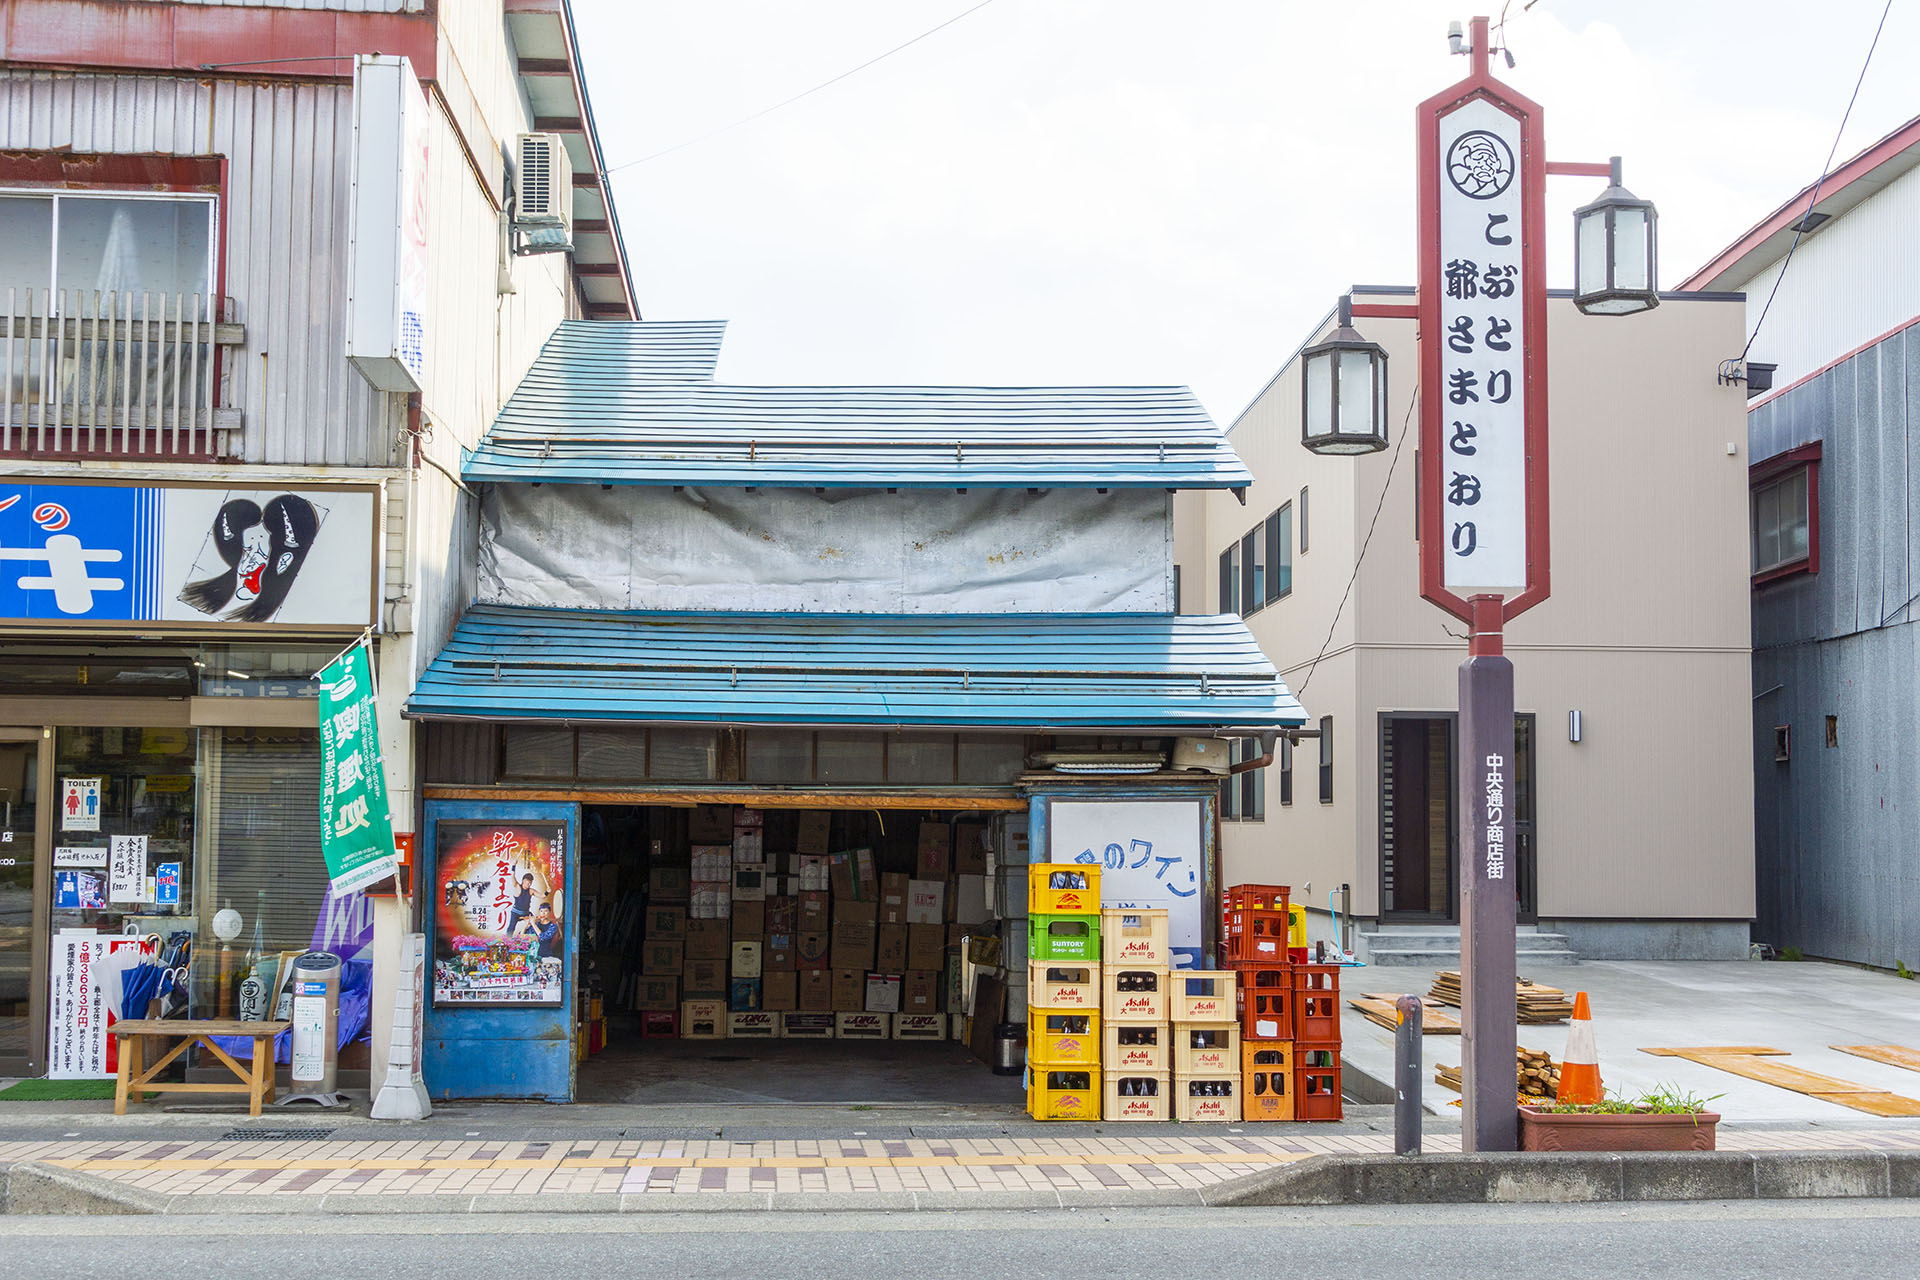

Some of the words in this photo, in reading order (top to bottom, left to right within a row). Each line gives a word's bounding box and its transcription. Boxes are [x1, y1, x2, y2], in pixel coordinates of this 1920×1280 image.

[1480, 212, 1518, 404] こぶとり
[1444, 258, 1481, 557] 爺さまとおり
[1485, 752, 1505, 879] 中央通り商店街
[158, 875, 175, 885] 110
[472, 907, 487, 915] 8.24
[478, 922, 487, 930] 26
[1125, 942, 1149, 951] Asahi
[1057, 988, 1078, 996] Asahi
[1125, 997, 1150, 1007] Asahi
[1194, 1002, 1216, 1010] Asahi
[64, 943, 76, 1072] 愛煙家の皆さん、ありがとうございます。
[1147, 1007, 1155, 1015] 20
[1127, 1051, 1149, 1059] Asahi
[1199, 1054, 1220, 1062] Asahi
[1128, 1101, 1149, 1109] Asahi
[1200, 1101, 1221, 1109] Asahi
